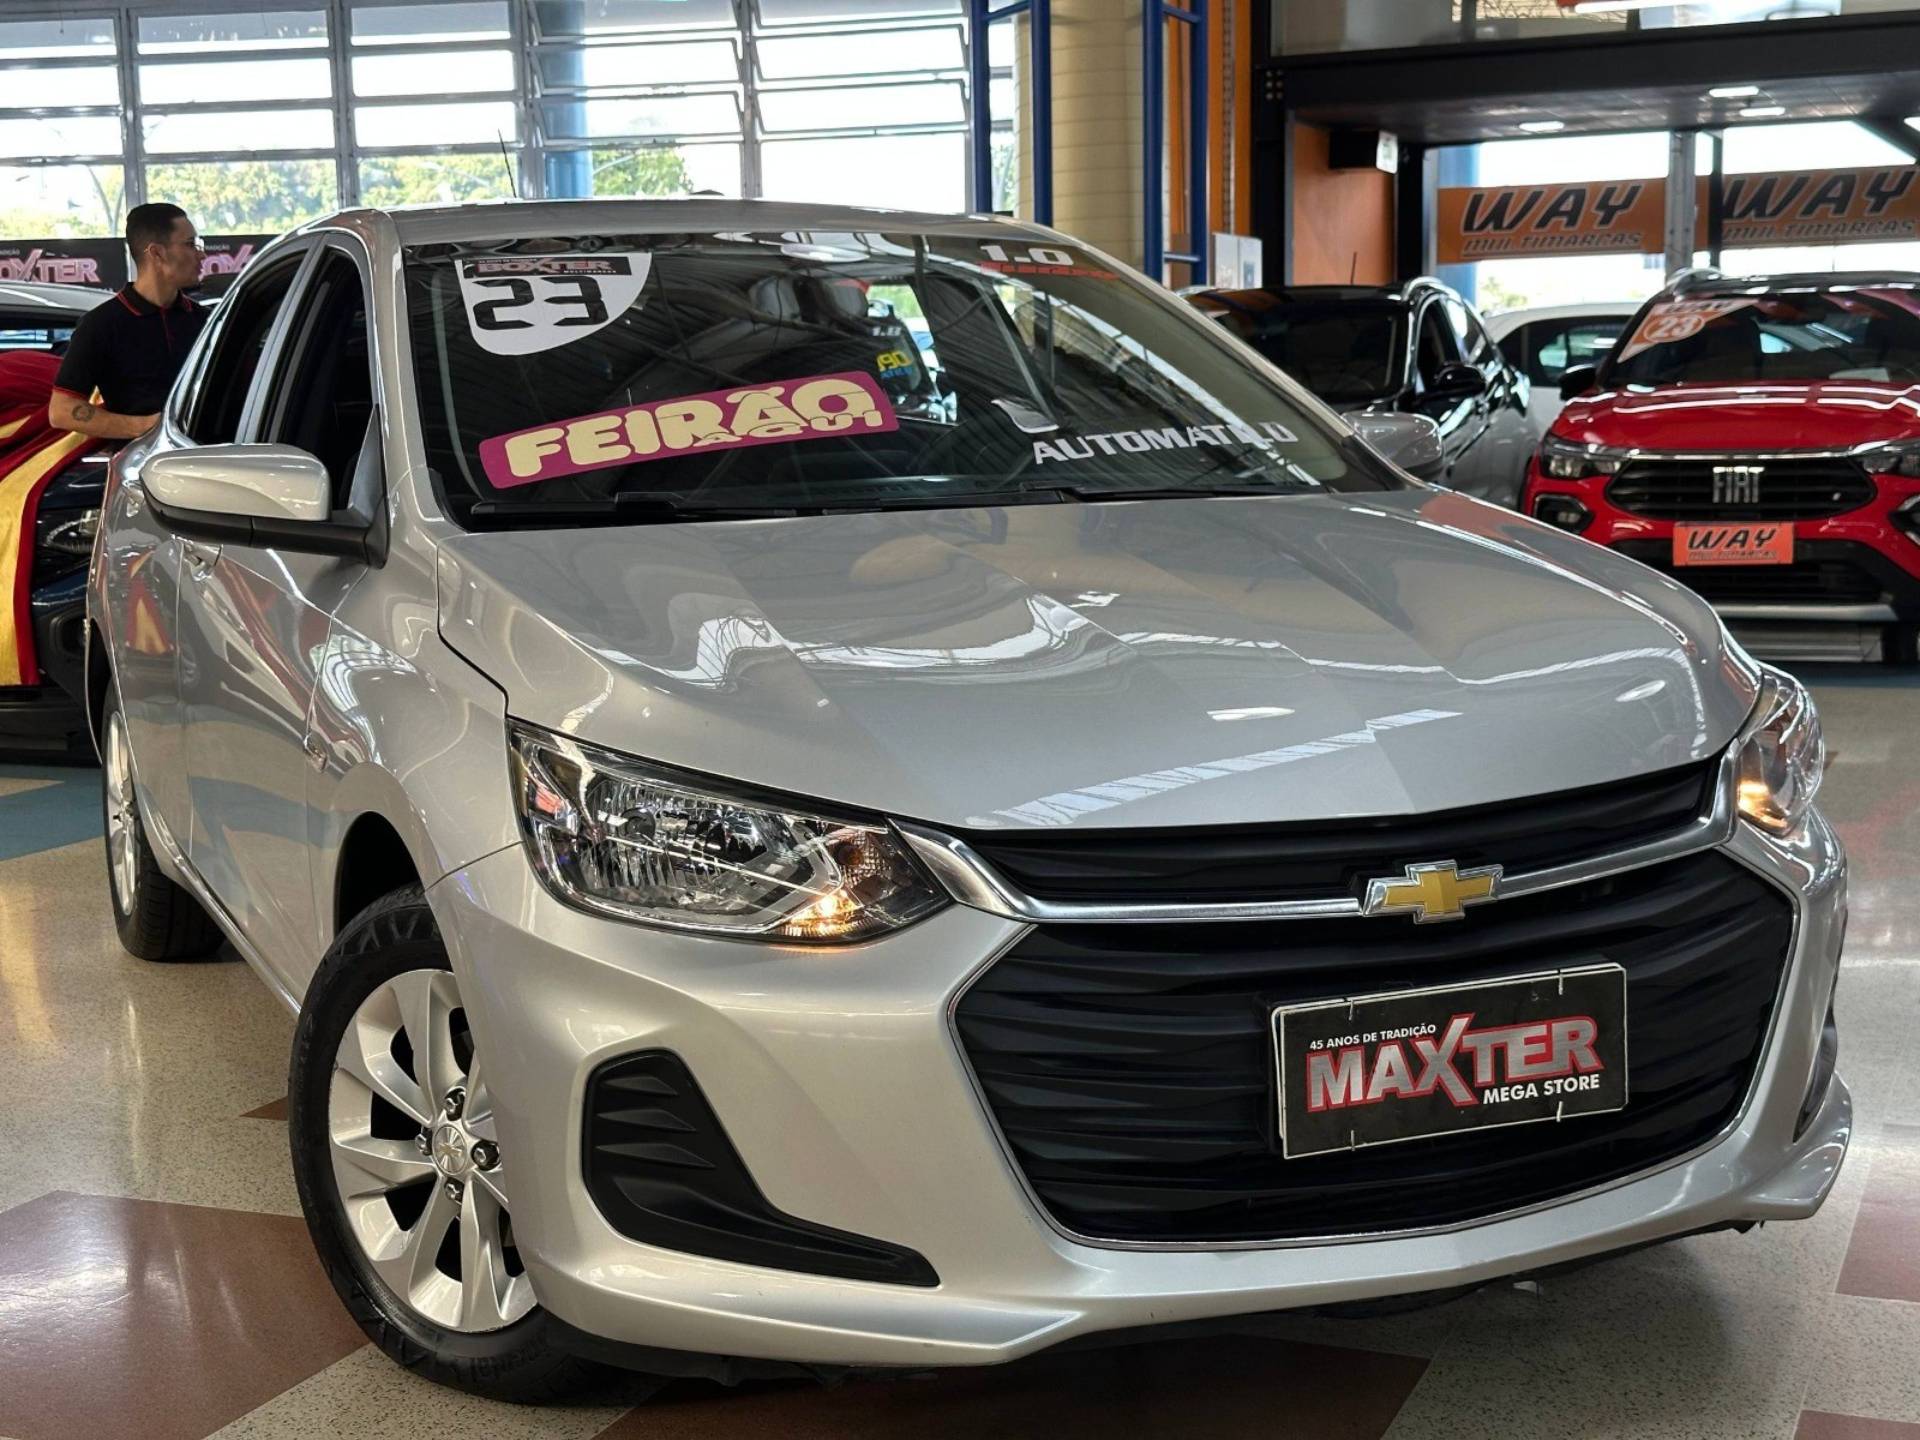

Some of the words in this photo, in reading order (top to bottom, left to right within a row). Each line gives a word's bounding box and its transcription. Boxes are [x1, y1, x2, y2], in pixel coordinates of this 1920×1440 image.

[1462, 185, 1644, 234] WAY
[1722, 170, 1916, 221] WAY
[0, 248, 101, 283] OXTER
[477, 257, 614, 274] BOXTER
[980, 245, 1074, 265] 1.0
[472, 275, 609, 331] 23
[505, 379, 877, 477] FEIRÃO
[1712, 466, 1765, 503] FIAT
[1688, 528, 1778, 550] WAY
[1309, 1040, 1324, 1051] 45
[1327, 1035, 1360, 1048] ANOS
[1363, 1032, 1378, 1043] DE
[1380, 1023, 1437, 1041] TRADIÇÃO
[1306, 1012, 1604, 1112] MAXTER
[1483, 1083, 1539, 1104] MEGA
[1543, 1073, 1600, 1096] STORE
